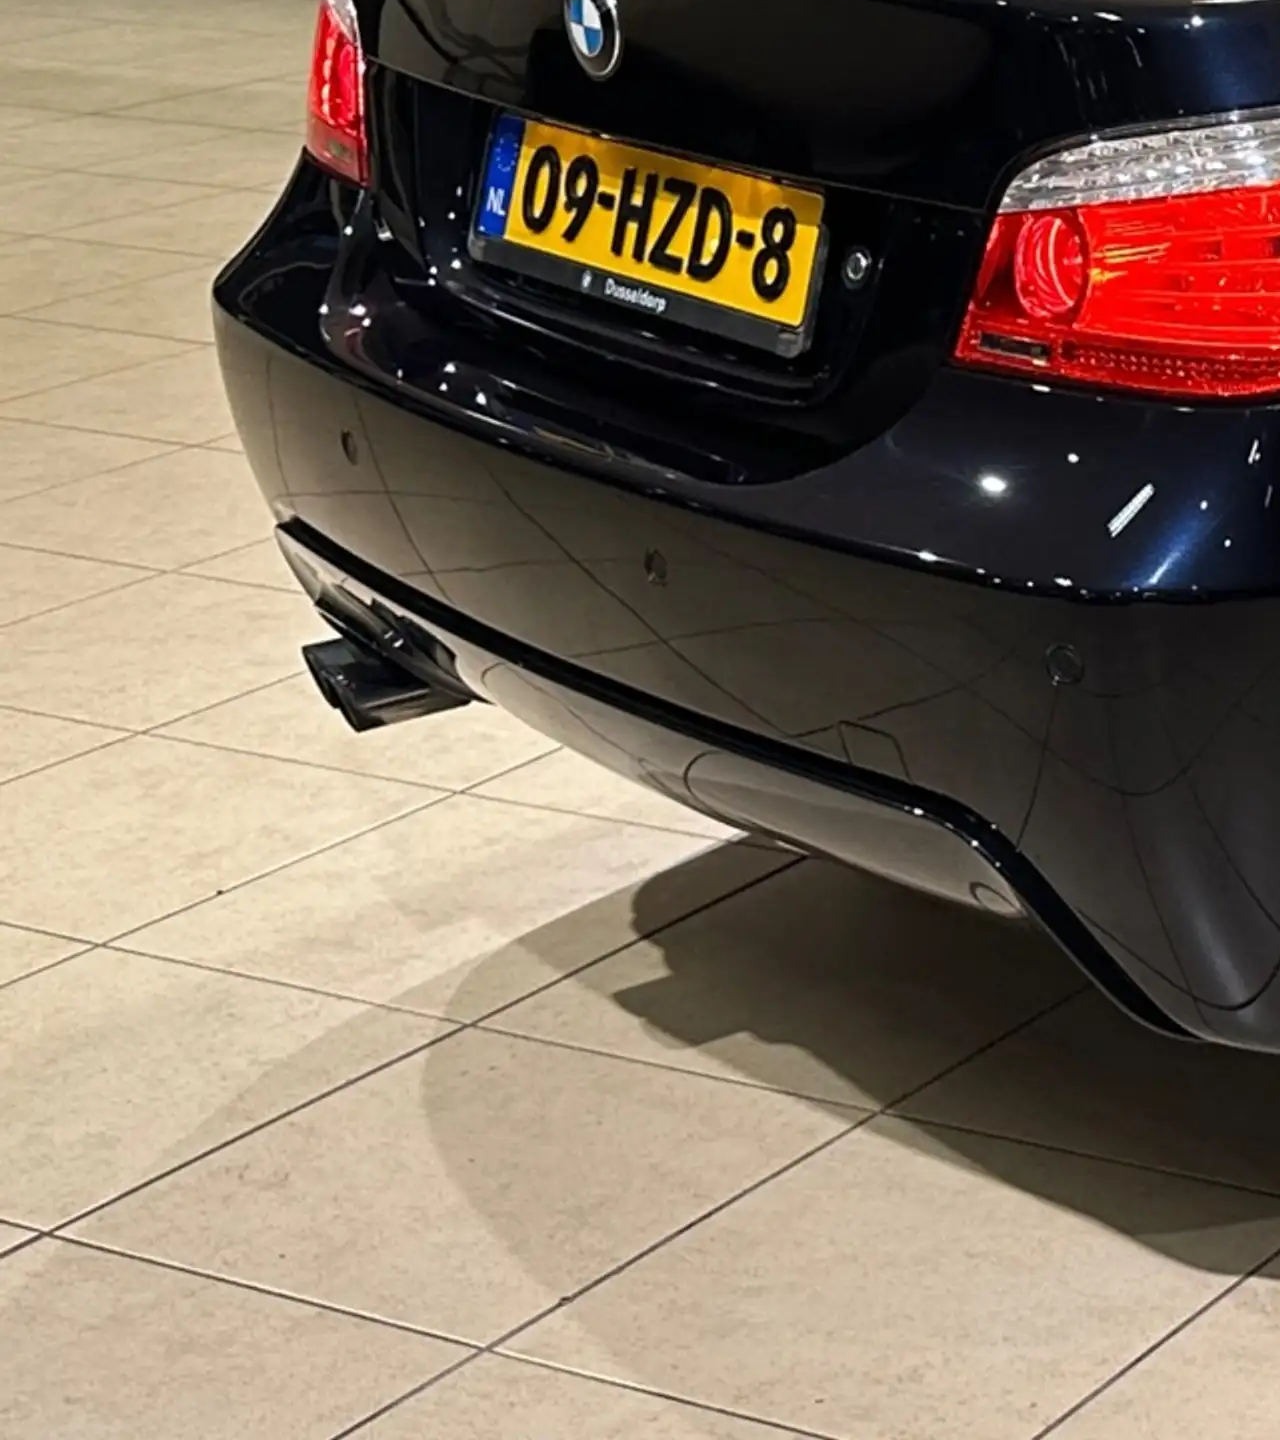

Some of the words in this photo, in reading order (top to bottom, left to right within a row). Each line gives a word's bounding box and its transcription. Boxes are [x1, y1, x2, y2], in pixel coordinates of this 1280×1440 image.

[486, 186, 506, 216] NL
[522, 144, 797, 303] 09-HZD-8
[604, 277, 667, 314] Dusseldorp
